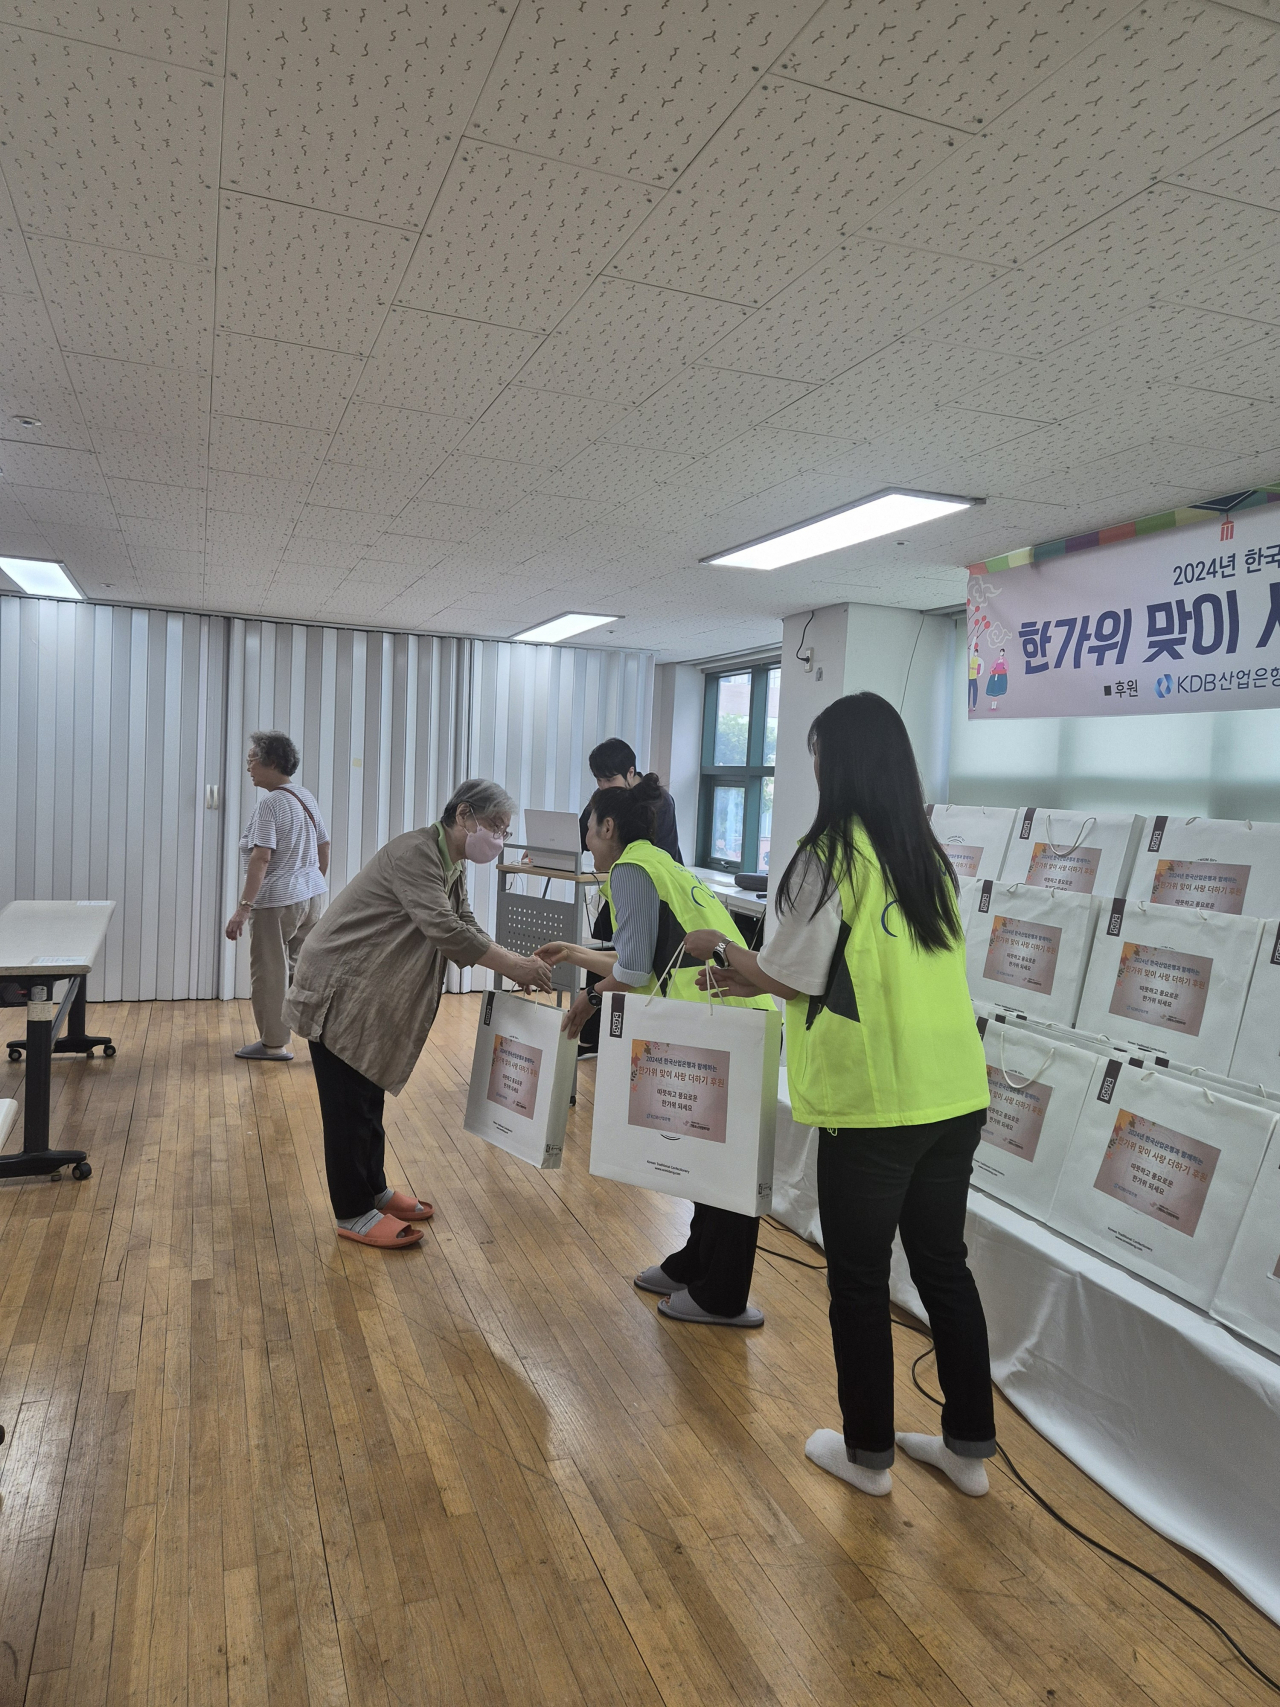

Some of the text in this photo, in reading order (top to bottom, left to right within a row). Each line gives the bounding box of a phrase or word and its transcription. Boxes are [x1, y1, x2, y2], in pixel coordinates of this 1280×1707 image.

[1174, 544, 1280, 586] 2024년 한국
[1018, 608, 1132, 675] 한가위
[1142, 590, 1240, 663] 맞이
[1114, 680, 1138, 698] 후원
[1160, 882, 1178, 890] 한가위
[1194, 884, 1206, 892] 사랑
[1208, 885, 1227, 894] 더하기
[1229, 888, 1242, 896] 후원
[1031, 943, 1045, 953] 더하기
[1134, 956, 1150, 966] 2024년
[1125, 965, 1205, 990] 한가위 맞이 사랑 더하기 후원
[1140, 986, 1179, 1000] 따뜻하고 풍요로운
[1142, 995, 1172, 1008] 한가위 되세요
[646, 1056, 663, 1064] 2024년
[664, 1058, 696, 1069] 한국산업은행과
[638, 1066, 724, 1088] 한가위 맞이 사랑 더하기 후원
[657, 1088, 698, 1102] 따뜻하고 풍요로운
[662, 1100, 692, 1112] 한가위 되세요
[1015, 1098, 1031, 1111] 더하기
[1128, 1129, 1144, 1141] 2024년
[1145, 1136, 1180, 1156] 한국산업은행과
[1117, 1136, 1208, 1183] 한가위 맞이 사랑 더하기 후원
[1130, 1163, 1174, 1188] 따뜻하고 풍요로운
[1132, 1175, 1165, 1195] 한가위 되세요
